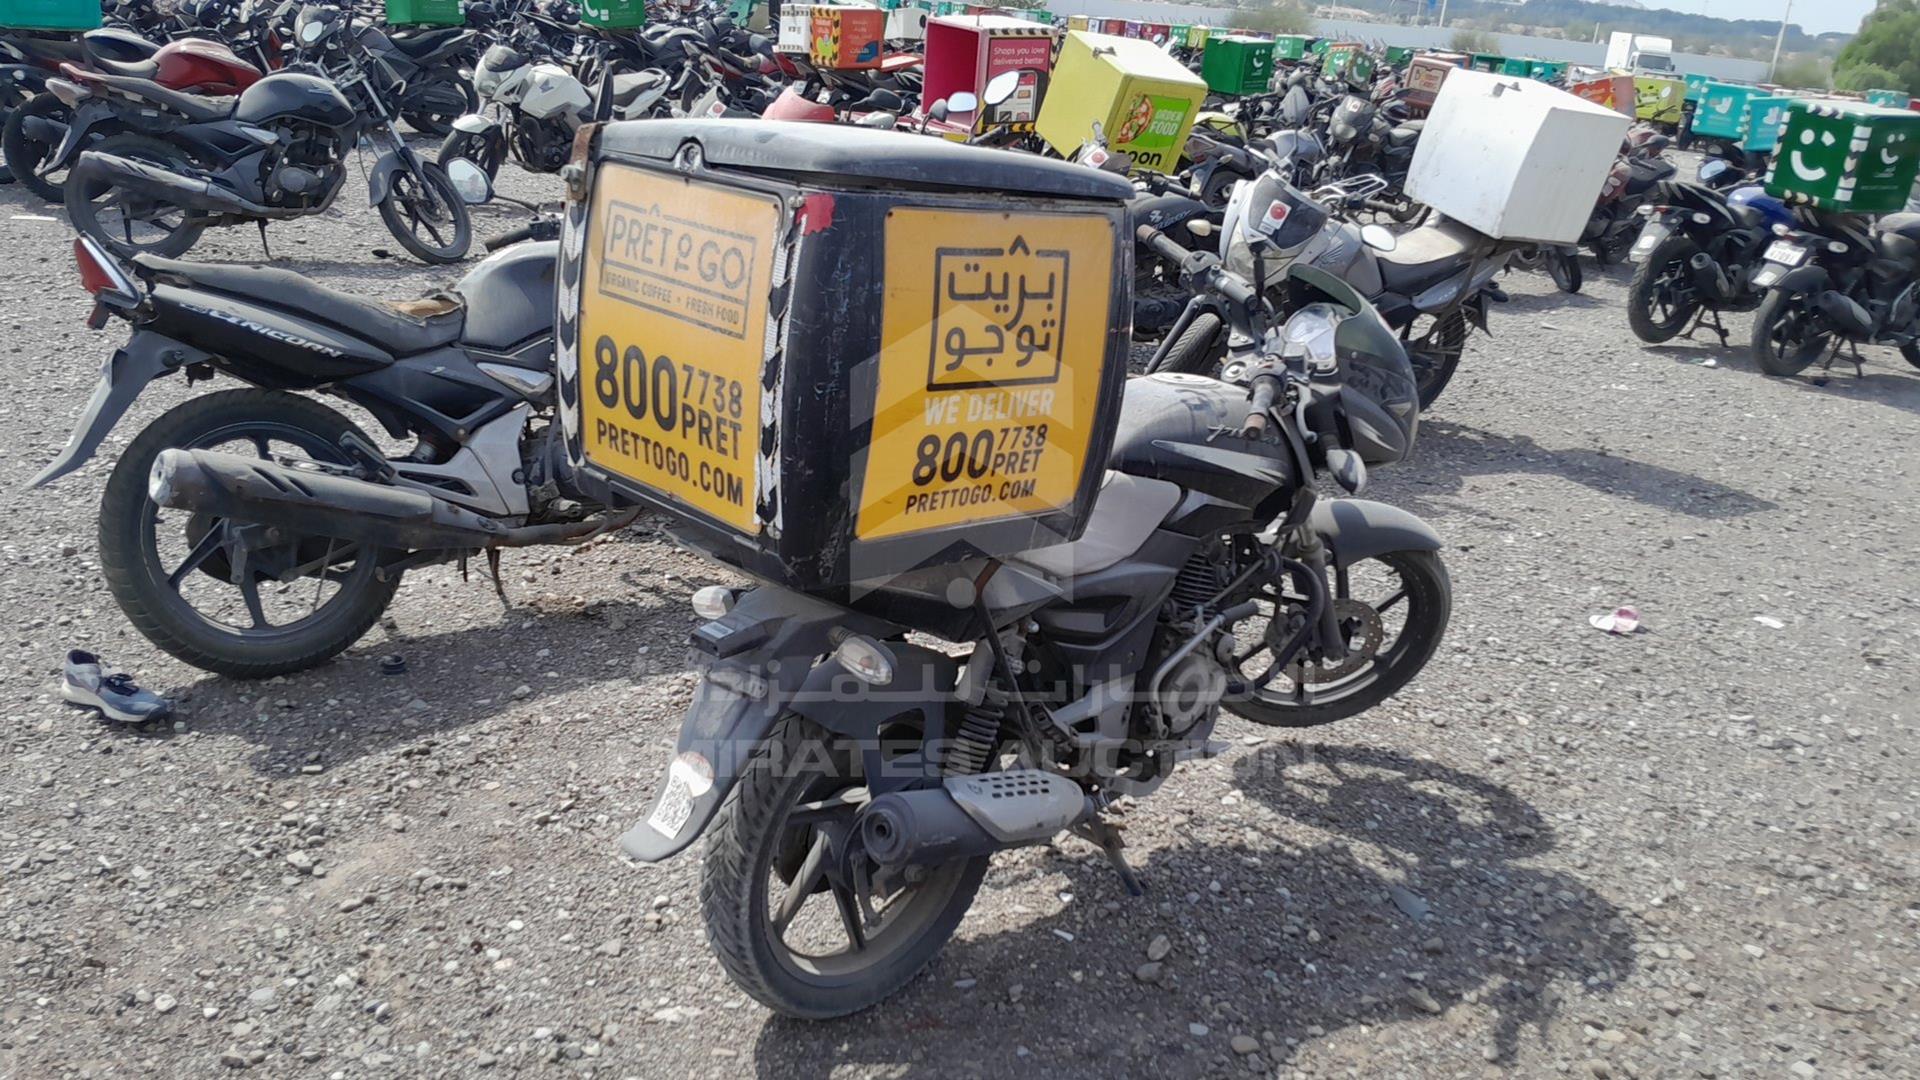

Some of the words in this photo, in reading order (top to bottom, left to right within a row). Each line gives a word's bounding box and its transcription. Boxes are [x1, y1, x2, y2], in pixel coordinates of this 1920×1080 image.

[993, 47, 1015, 56] Shops
[1017, 47, 1030, 56] you
[1031, 46, 1045, 55] love
[993, 57, 1023, 65] delivered
[1024, 57, 1044, 65] better
[1149, 120, 1179, 135] FOOD
[697, 240, 745, 289] GO
[605, 271, 640, 294] ORGANIC
[641, 281, 673, 304] COFFEE
[686, 296, 715, 317] FRESH
[716, 304, 740, 325] FOOD
[947, 263, 1057, 332] بريت
[208, 308, 345, 358] UNICORN
[944, 319, 1056, 372] توجو
[595, 334, 678, 432] 800
[682, 363, 743, 420] 7738
[925, 395, 960, 426] WE
[968, 388, 1056, 423] DELIVER
[681, 402, 742, 460] PRET
[912, 429, 994, 487] 800
[997, 423, 1049, 450] 7738
[597, 418, 744, 508] PRETTOGO.COM
[991, 448, 1044, 478] PRET
[904, 479, 1038, 514] PRETTOGO.COM
